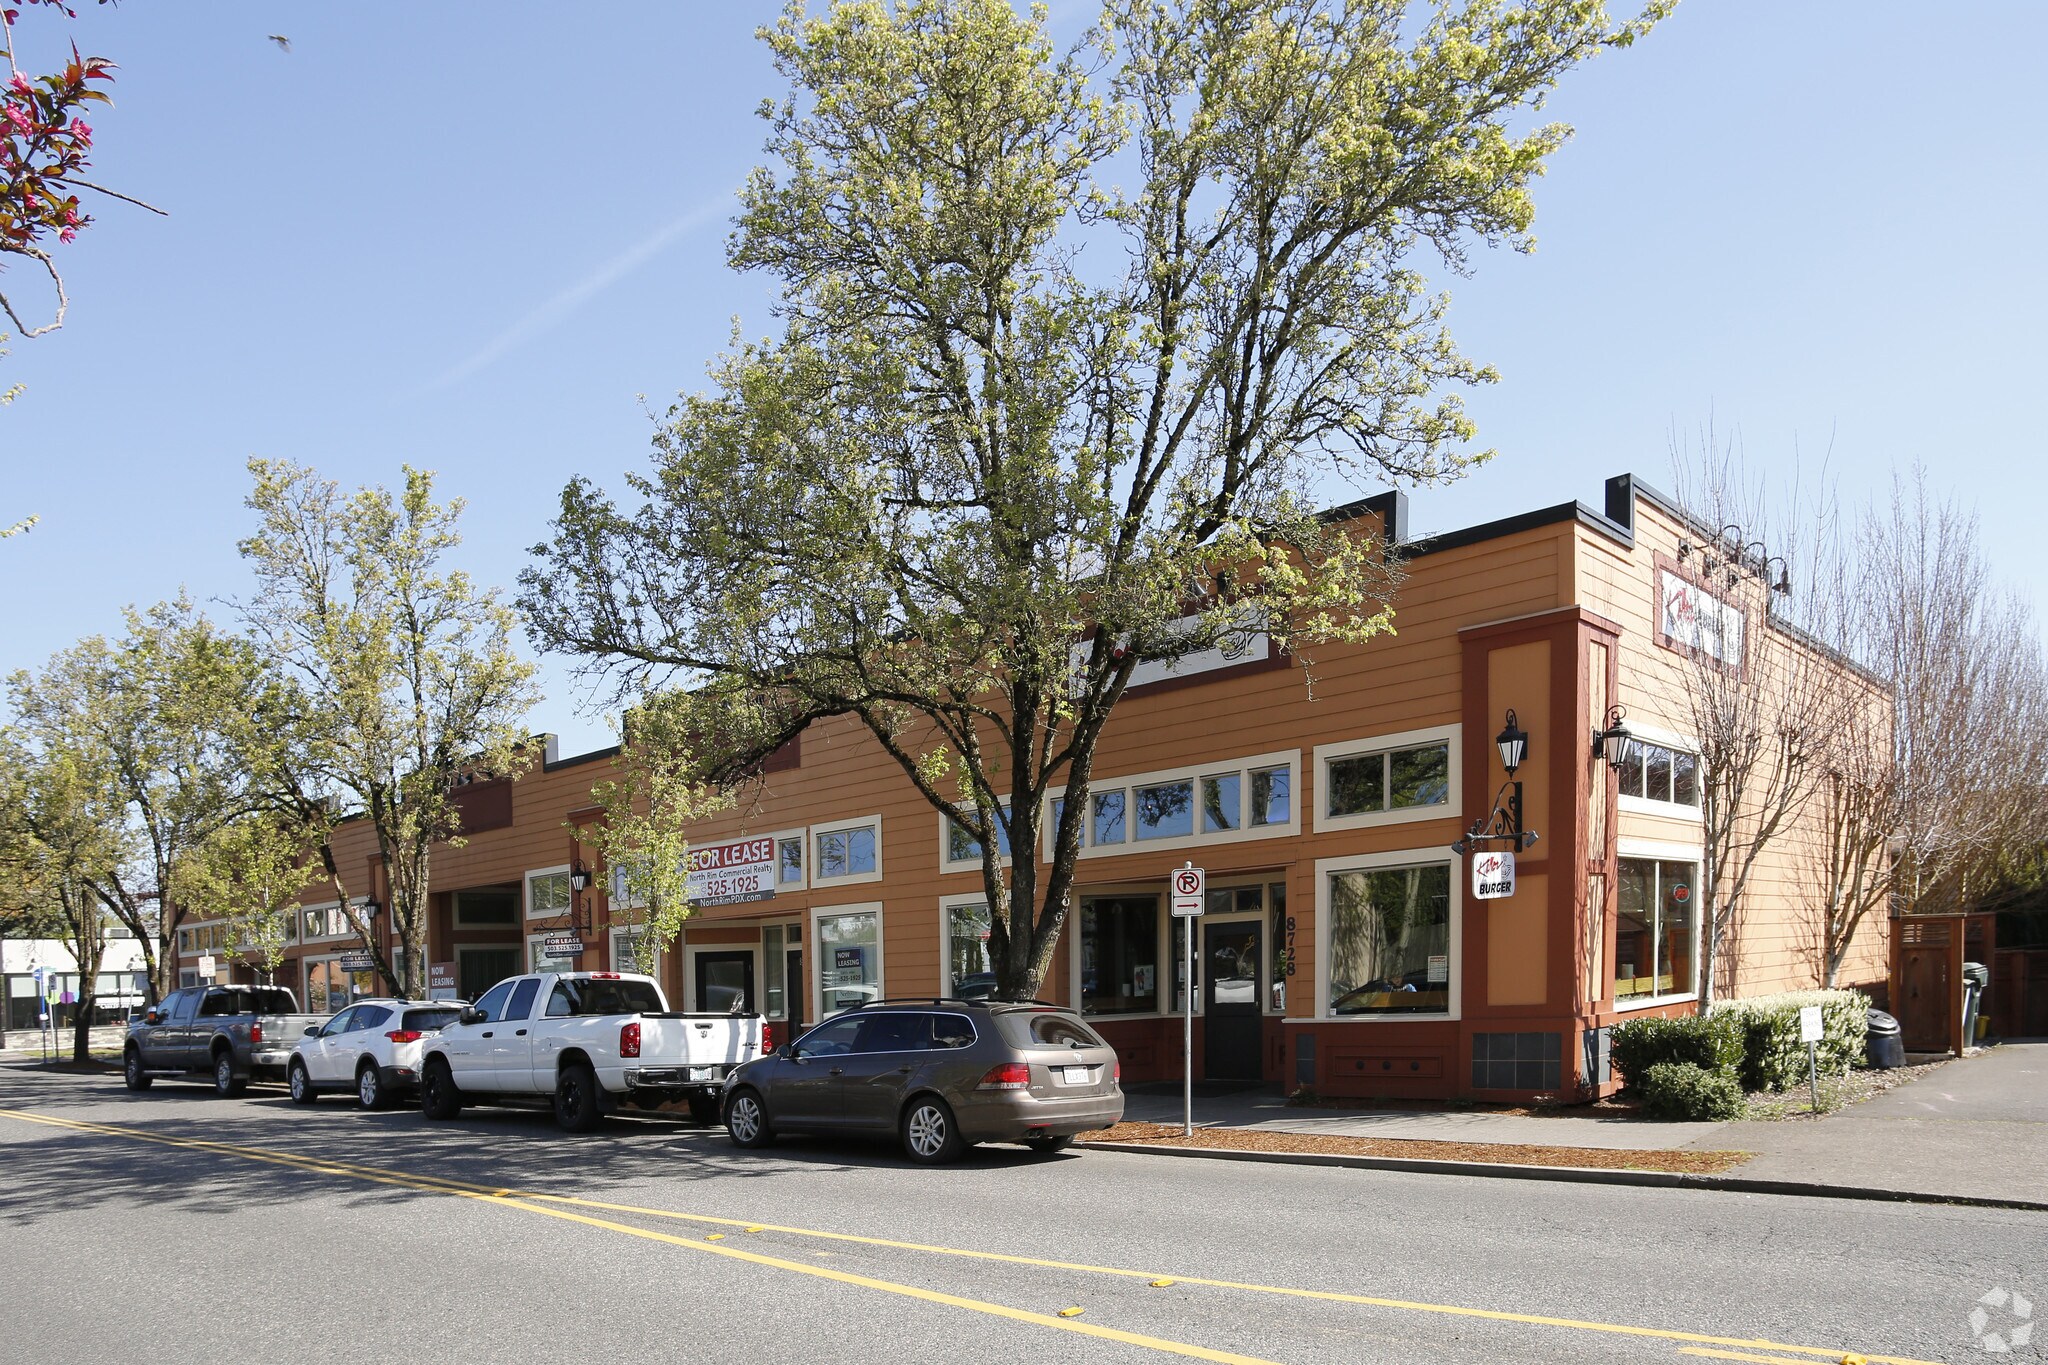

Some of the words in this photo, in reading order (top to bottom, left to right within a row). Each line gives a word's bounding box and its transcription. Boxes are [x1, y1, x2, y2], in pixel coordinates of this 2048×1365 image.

[691, 849, 720, 870] FOR
[724, 840, 770, 866] LEASE
[690, 872, 706, 882] North
[707, 871, 717, 879] Rim
[718, 866, 753, 879] Commercial
[753, 863, 773, 874] Realty
[707, 875, 759, 897] 525-1925
[1479, 881, 1512, 895] BURGER
[700, 893, 762, 907] NorthRimPDX.com
[1286, 916, 1296, 977] 8728
[837, 951, 850, 959] NOW
[837, 958, 860, 967] LEASING
[431, 966, 445, 976] NOW
[431, 977, 455, 987] LEASING
